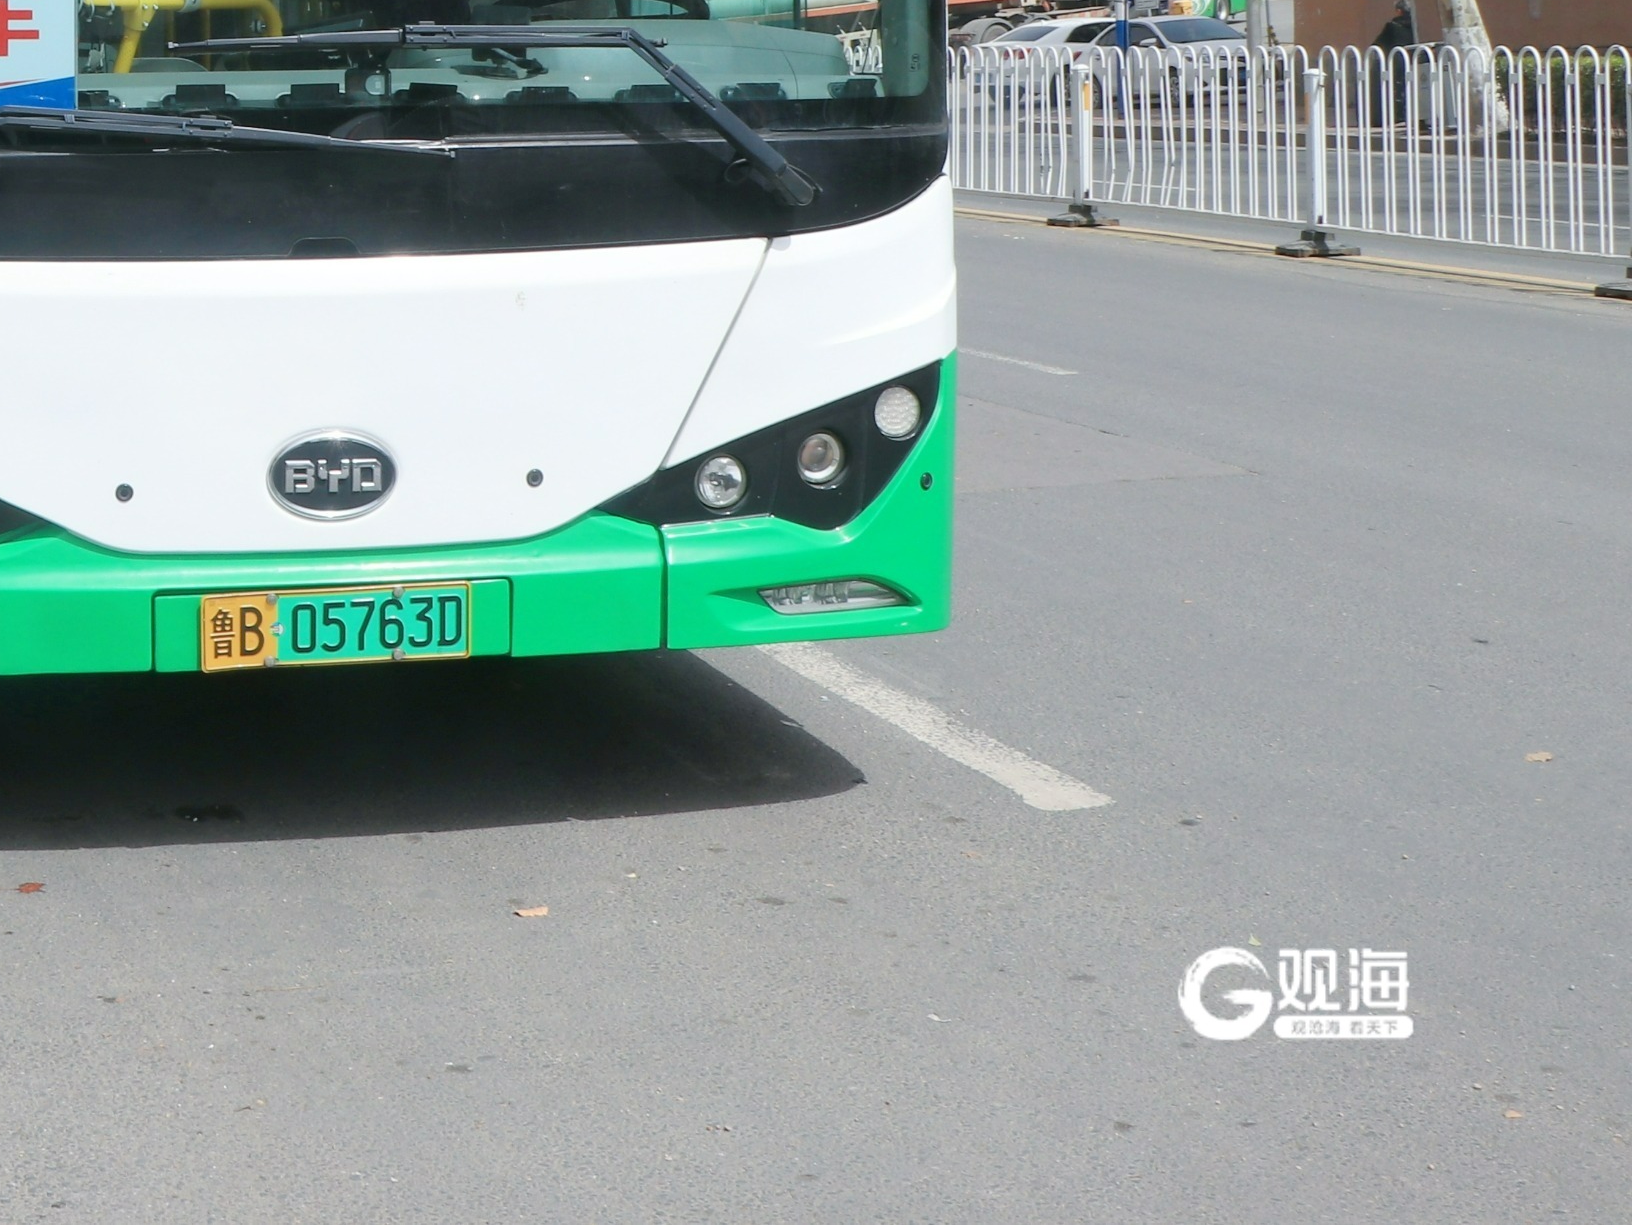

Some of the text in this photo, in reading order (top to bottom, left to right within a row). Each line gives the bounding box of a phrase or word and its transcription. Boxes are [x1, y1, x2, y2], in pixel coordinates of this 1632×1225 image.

[284, 458, 382, 494] BYD
[209, 596, 463, 659] 鲁B 05763D
